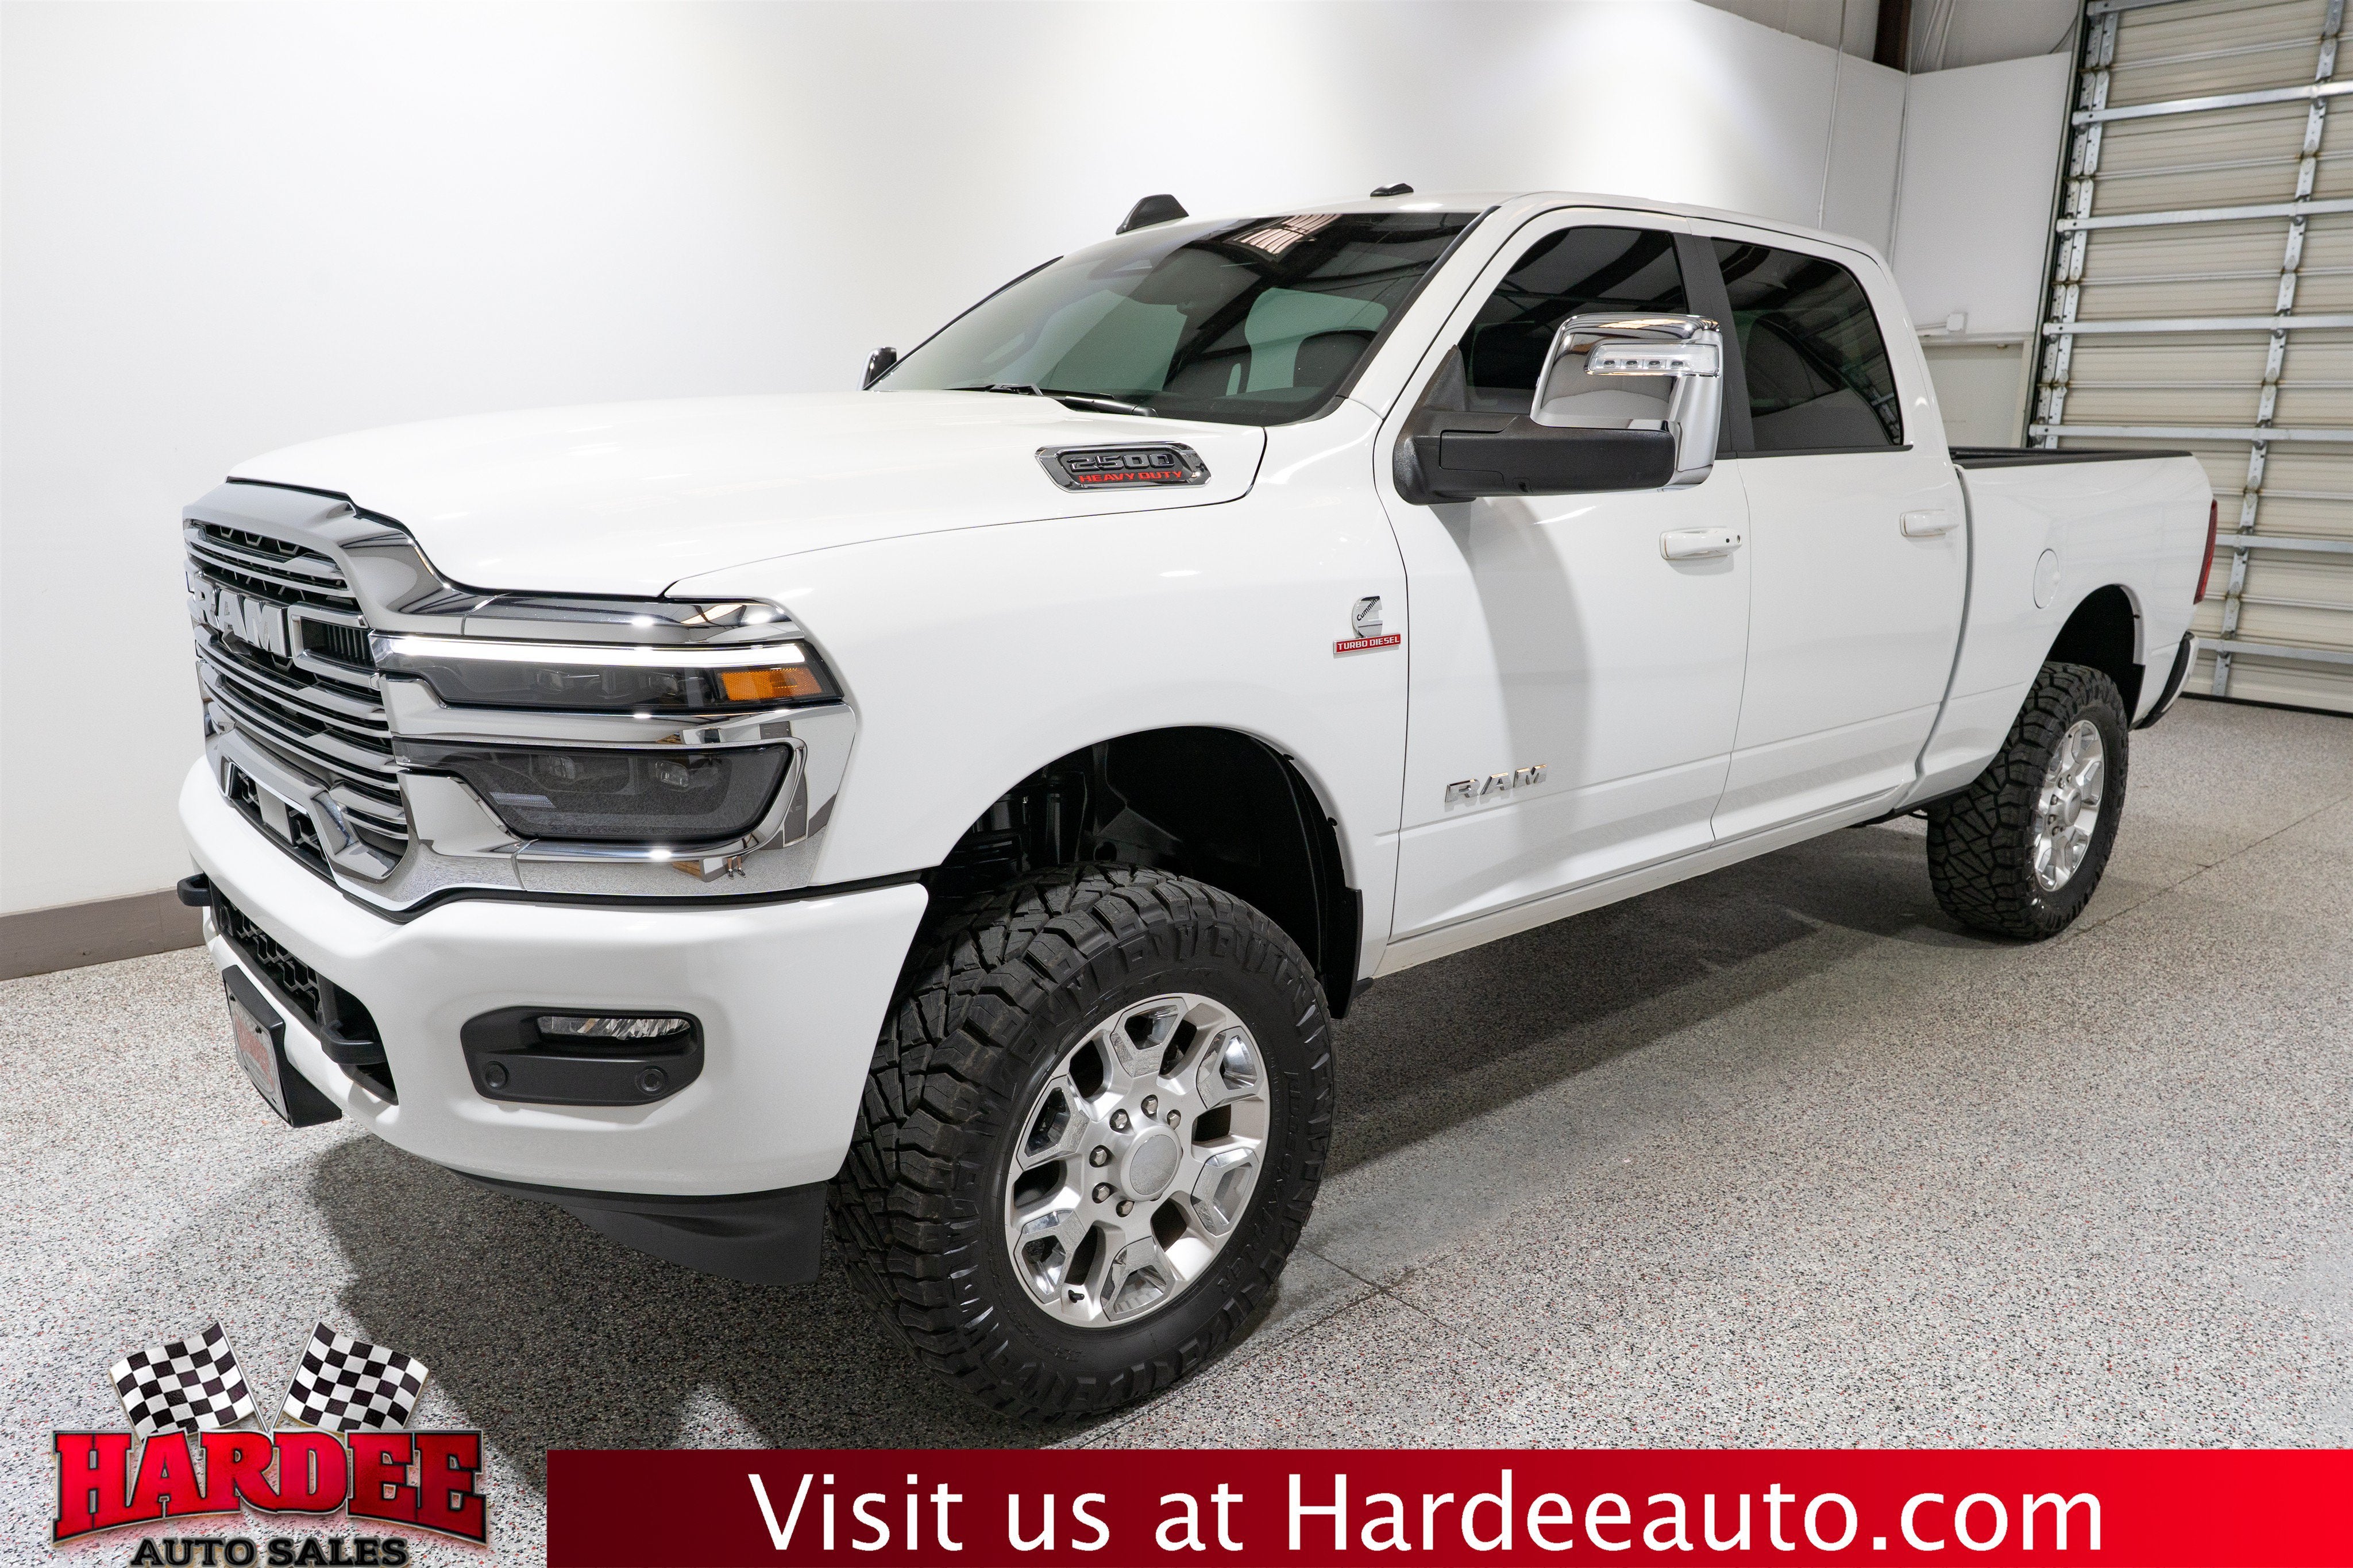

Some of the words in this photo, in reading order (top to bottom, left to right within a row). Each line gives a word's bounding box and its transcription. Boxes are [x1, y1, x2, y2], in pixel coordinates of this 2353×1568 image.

[1067, 453, 1175, 472] 2500
[1078, 472, 1139, 483] HEAVY
[1138, 470, 1183, 480] DUTY
[194, 574, 288, 658] RAM
[1337, 640, 1368, 650] TURBO
[1370, 636, 1400, 647] DIESEL
[1444, 764, 1548, 803] RAM
